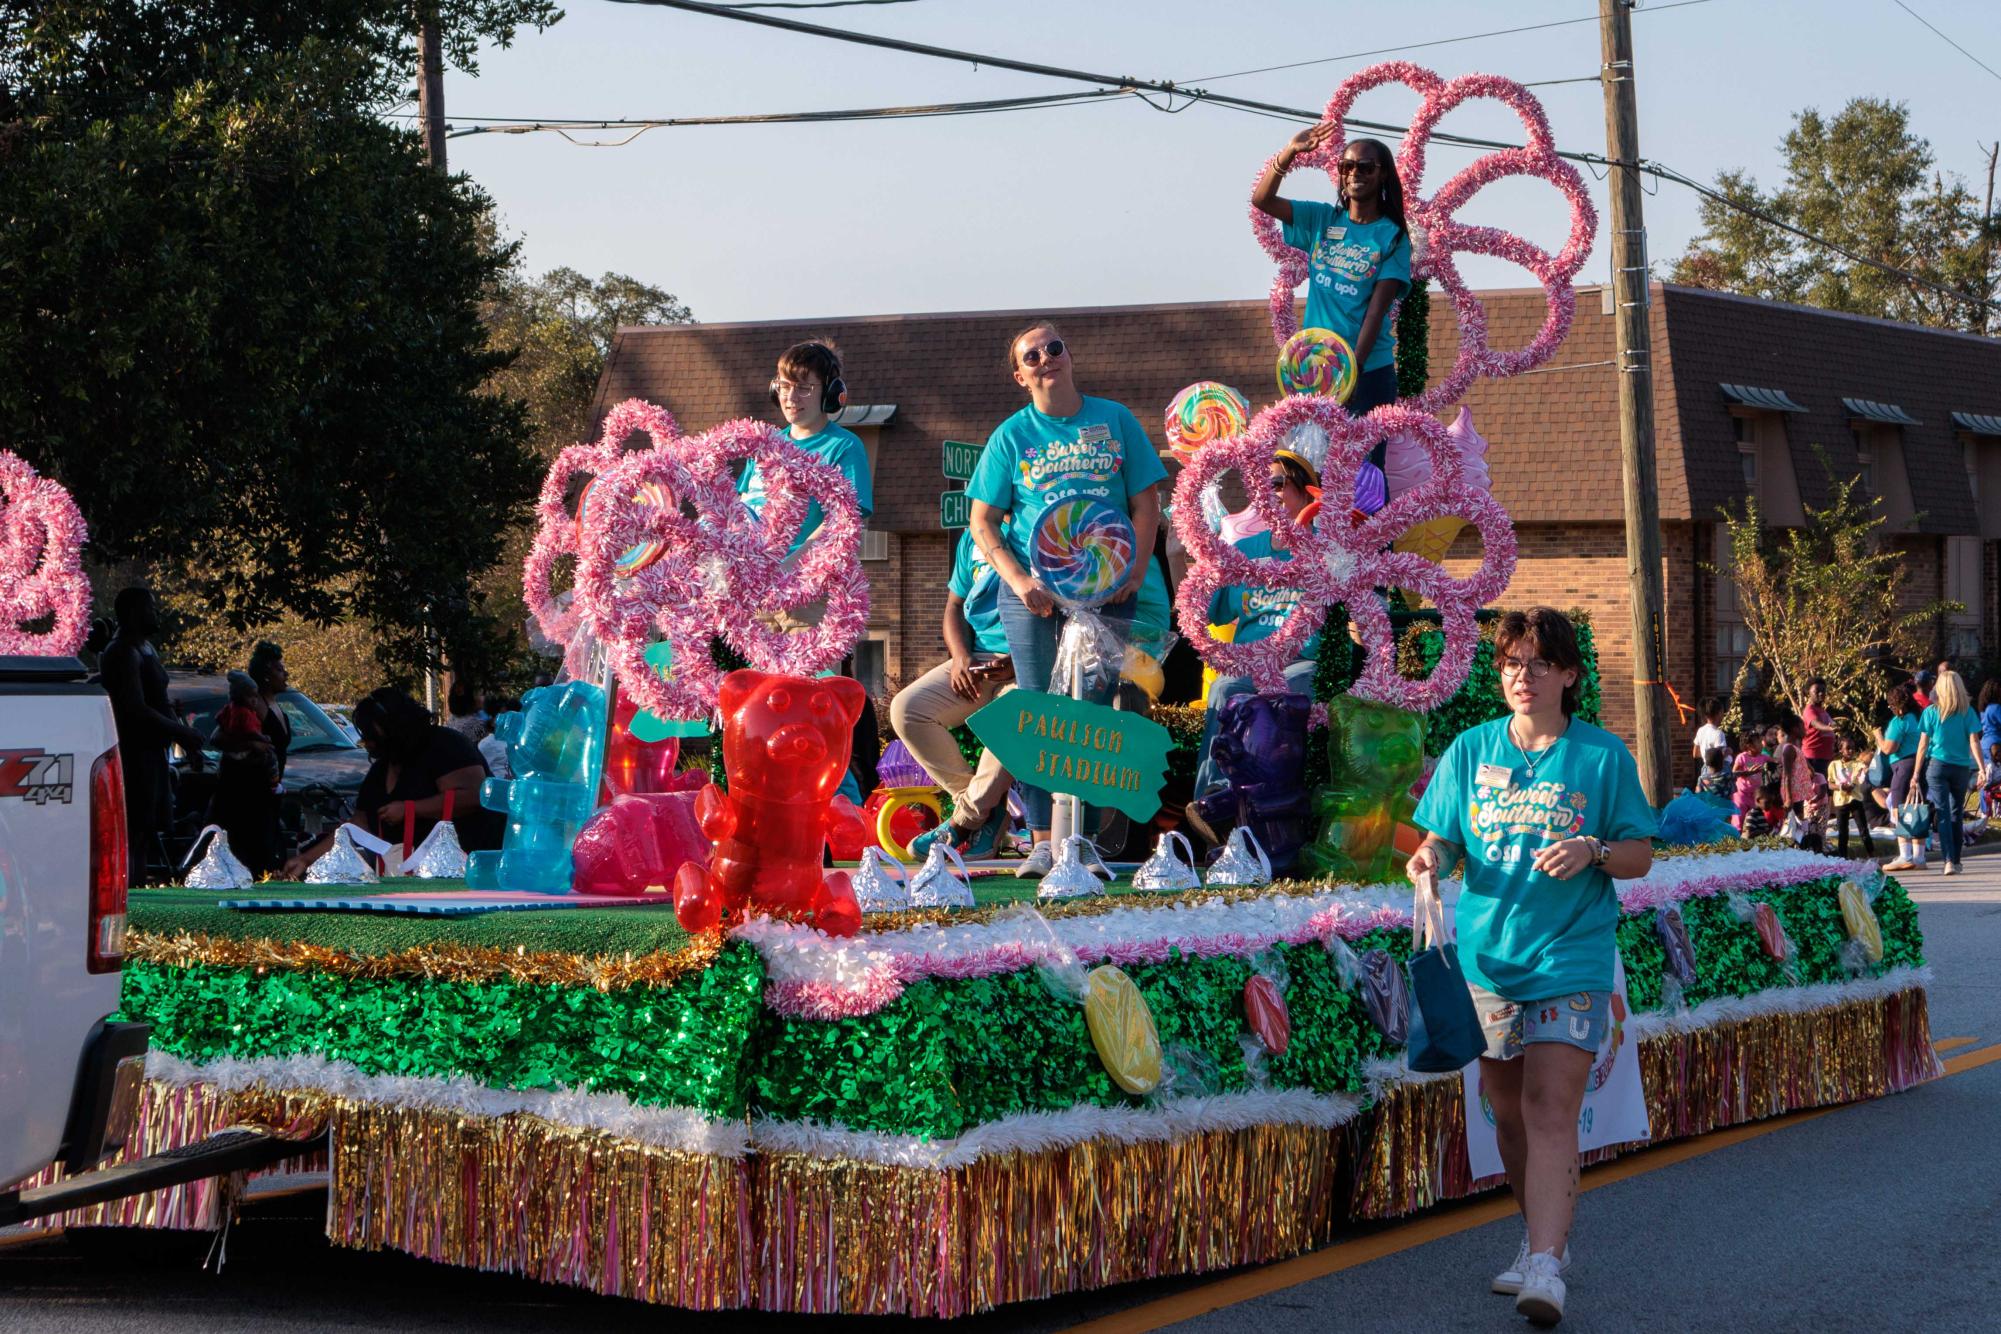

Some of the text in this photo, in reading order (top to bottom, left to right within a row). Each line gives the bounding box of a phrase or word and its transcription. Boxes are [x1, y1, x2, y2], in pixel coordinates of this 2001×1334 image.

[946, 446, 982, 475] NORT
[1031, 453, 1113, 479] Southern
[1017, 709, 1123, 753] PAULSON
[1035, 750, 1141, 792] STADIUM
[1498, 781, 1565, 808] Sweet
[1478, 801, 1573, 827] Southern
